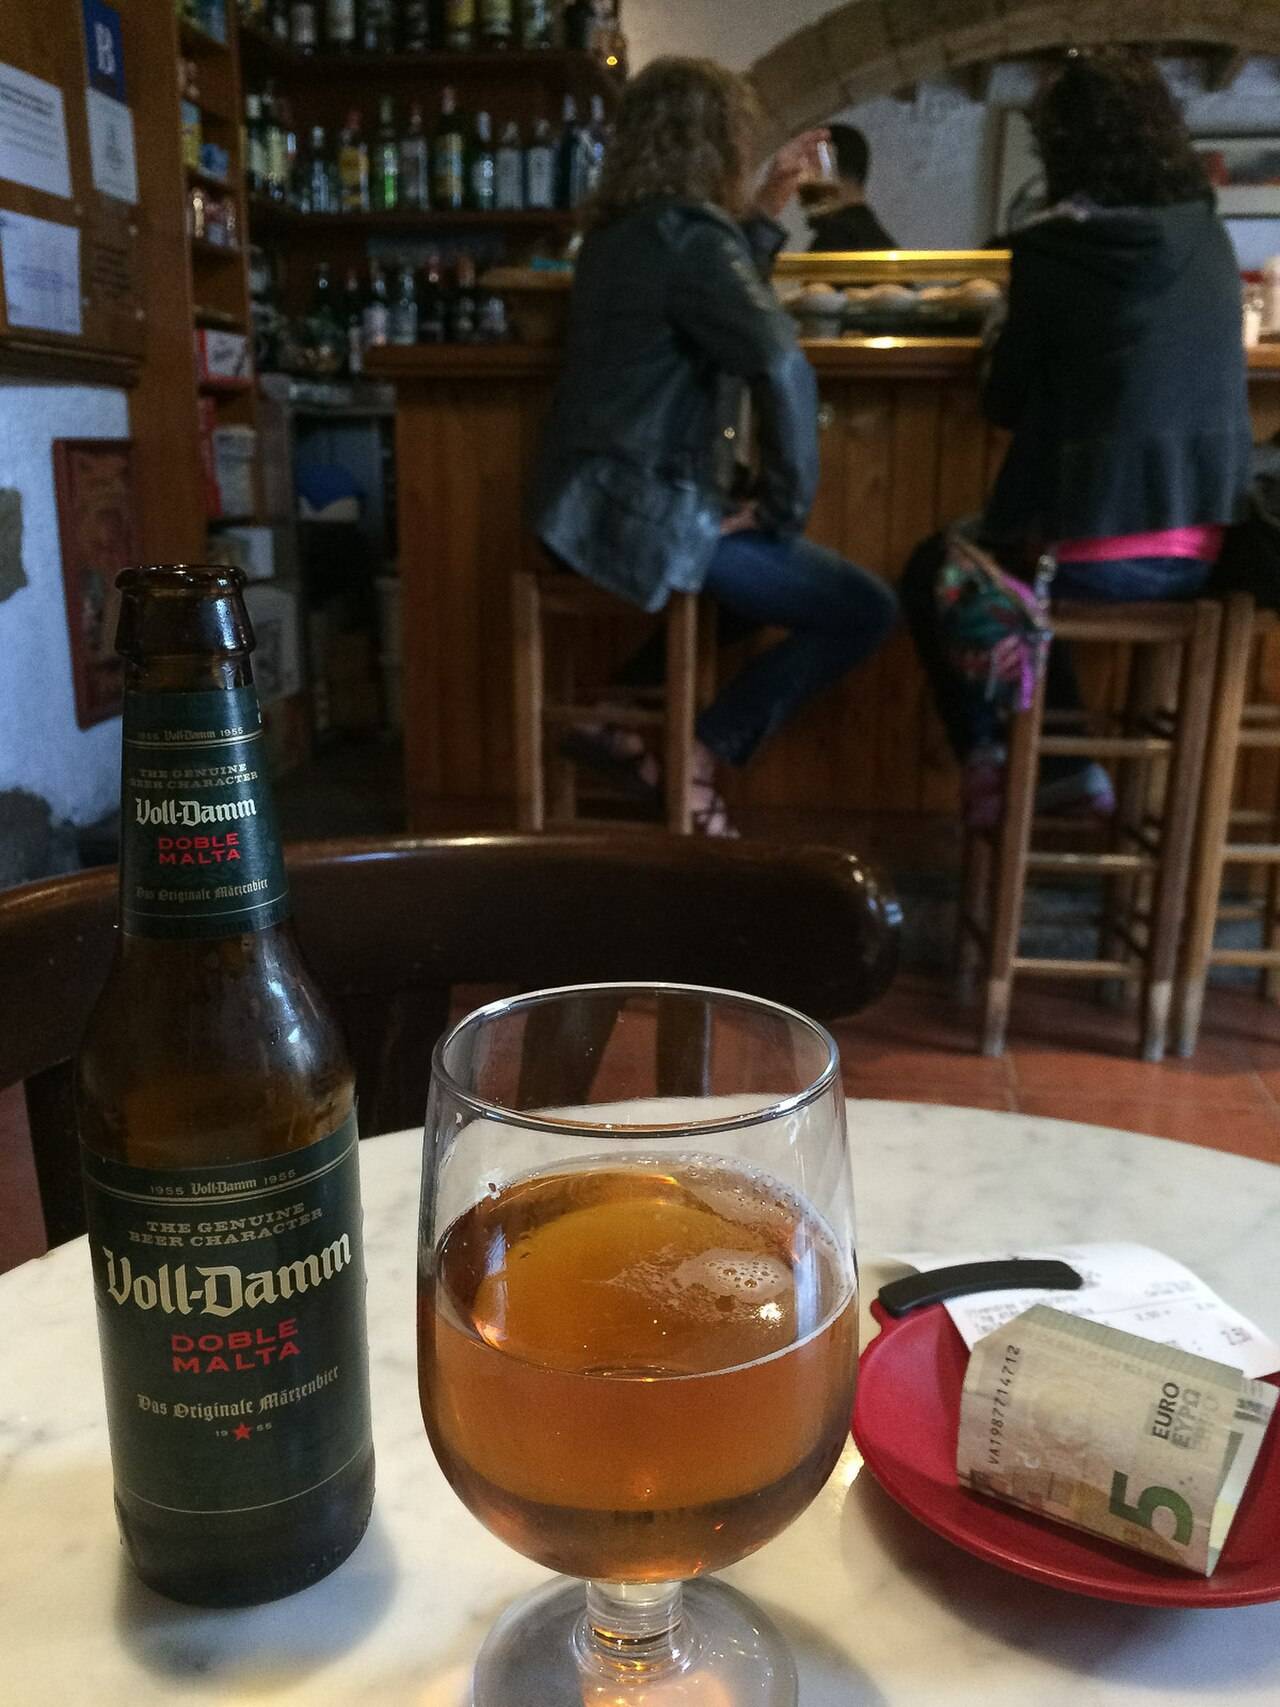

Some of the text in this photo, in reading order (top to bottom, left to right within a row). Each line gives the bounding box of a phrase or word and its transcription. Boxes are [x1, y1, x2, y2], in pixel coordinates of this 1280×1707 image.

[140, 763, 247, 779] THE GENUINE
[167, 771, 259, 789] CHARACTER
[135, 797, 257, 827] Voll-Damm
[158, 832, 239, 849] DOBLE
[159, 848, 240, 865] MALTA
[150, 1185, 184, 1196] 1955
[264, 1169, 297, 1185] 1955
[128, 1208, 323, 1247] BEER CHARACTER
[146, 1202, 305, 1234] THE GENUINE
[103, 1233, 352, 1317] Voll-Damm
[171, 1318, 298, 1352] DOBLE
[172, 1341, 300, 1374] MALTA
[137, 1365, 339, 1421] Das Originale Märzenbier
[1152, 1382, 1180, 1440] EURO
[1109, 1470, 1194, 1546] 5
